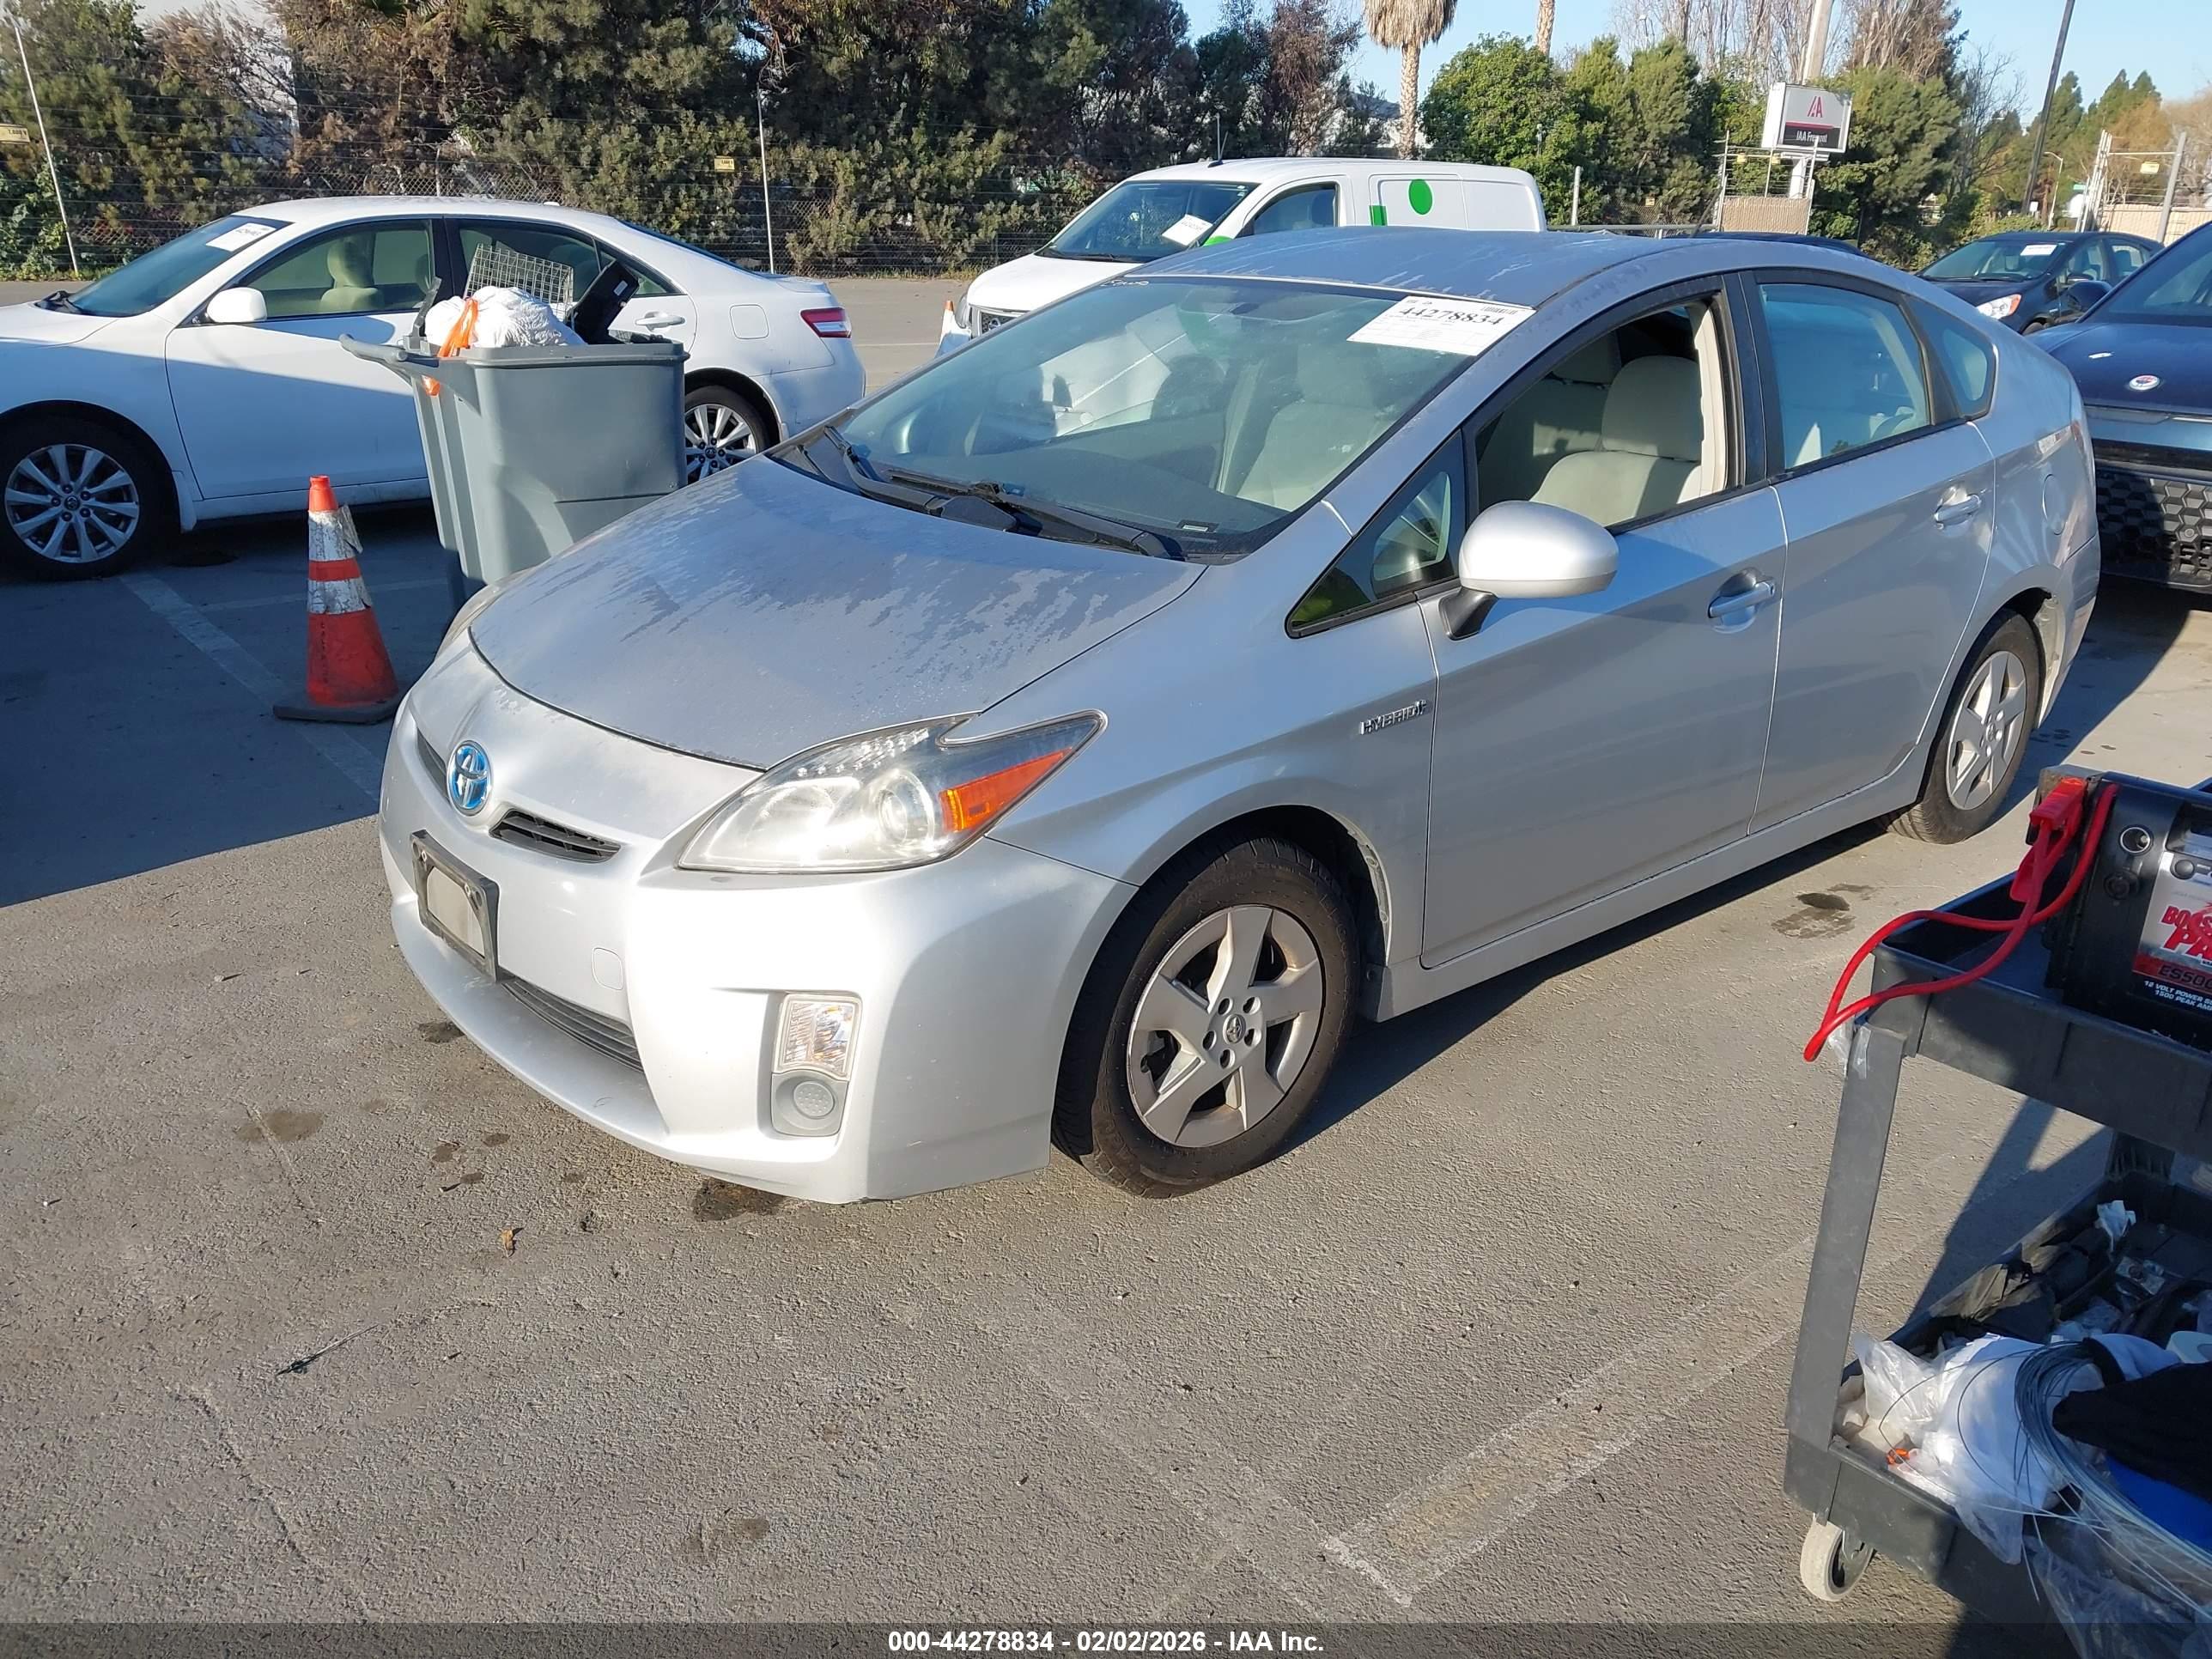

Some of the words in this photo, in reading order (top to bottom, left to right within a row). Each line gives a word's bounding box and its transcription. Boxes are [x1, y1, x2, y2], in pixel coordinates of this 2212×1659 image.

[1398, 306, 1505, 326] 44278834
[1359, 705, 1418, 735] HYBRID
[2154, 989, 2174, 1000] 1500
[2175, 995, 2196, 1006] PEAK
[2155, 983, 2175, 994] VOLT
[2175, 989, 2203, 1002] POWER
